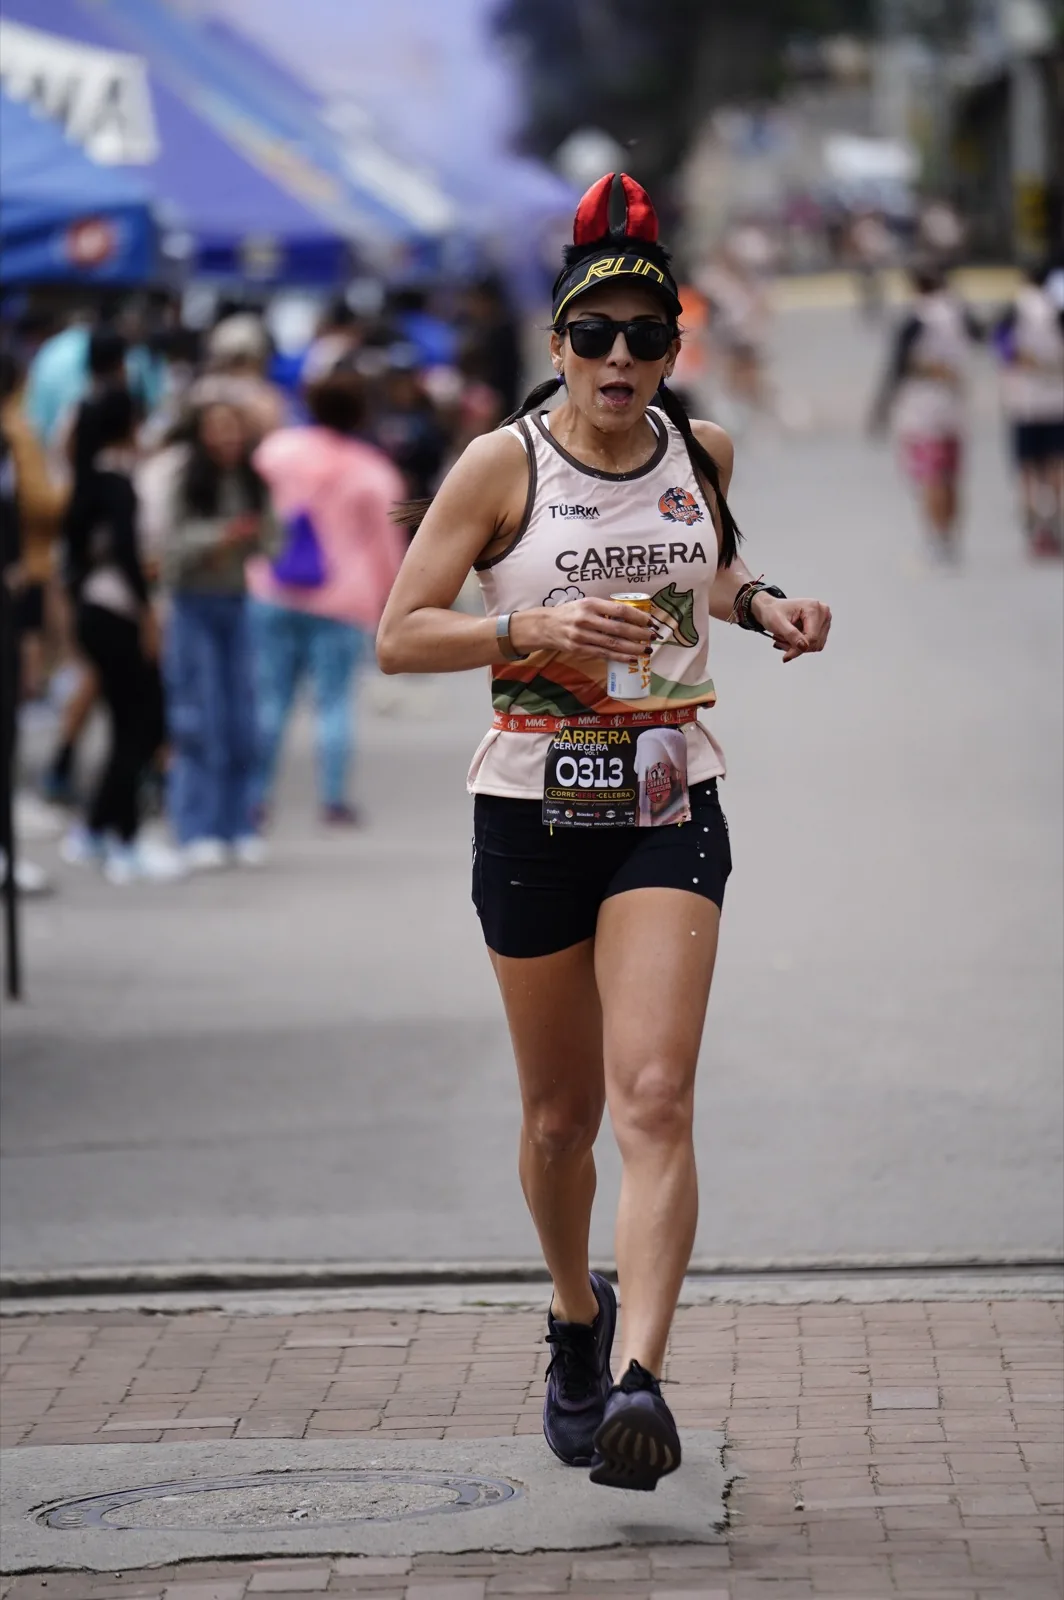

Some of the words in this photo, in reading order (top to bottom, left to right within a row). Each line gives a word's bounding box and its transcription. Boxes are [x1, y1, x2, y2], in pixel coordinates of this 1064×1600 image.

[585, 257, 665, 284] RUN
[555, 542, 707, 572] CARRERA
[567, 563, 669, 583] CERVECERA
[525, 718, 548, 727] MMC
[578, 716, 601, 724] MMC
[632, 711, 653, 720] MMC
[553, 741, 609, 752] CERVECERA
[555, 756, 624, 788] 0313
